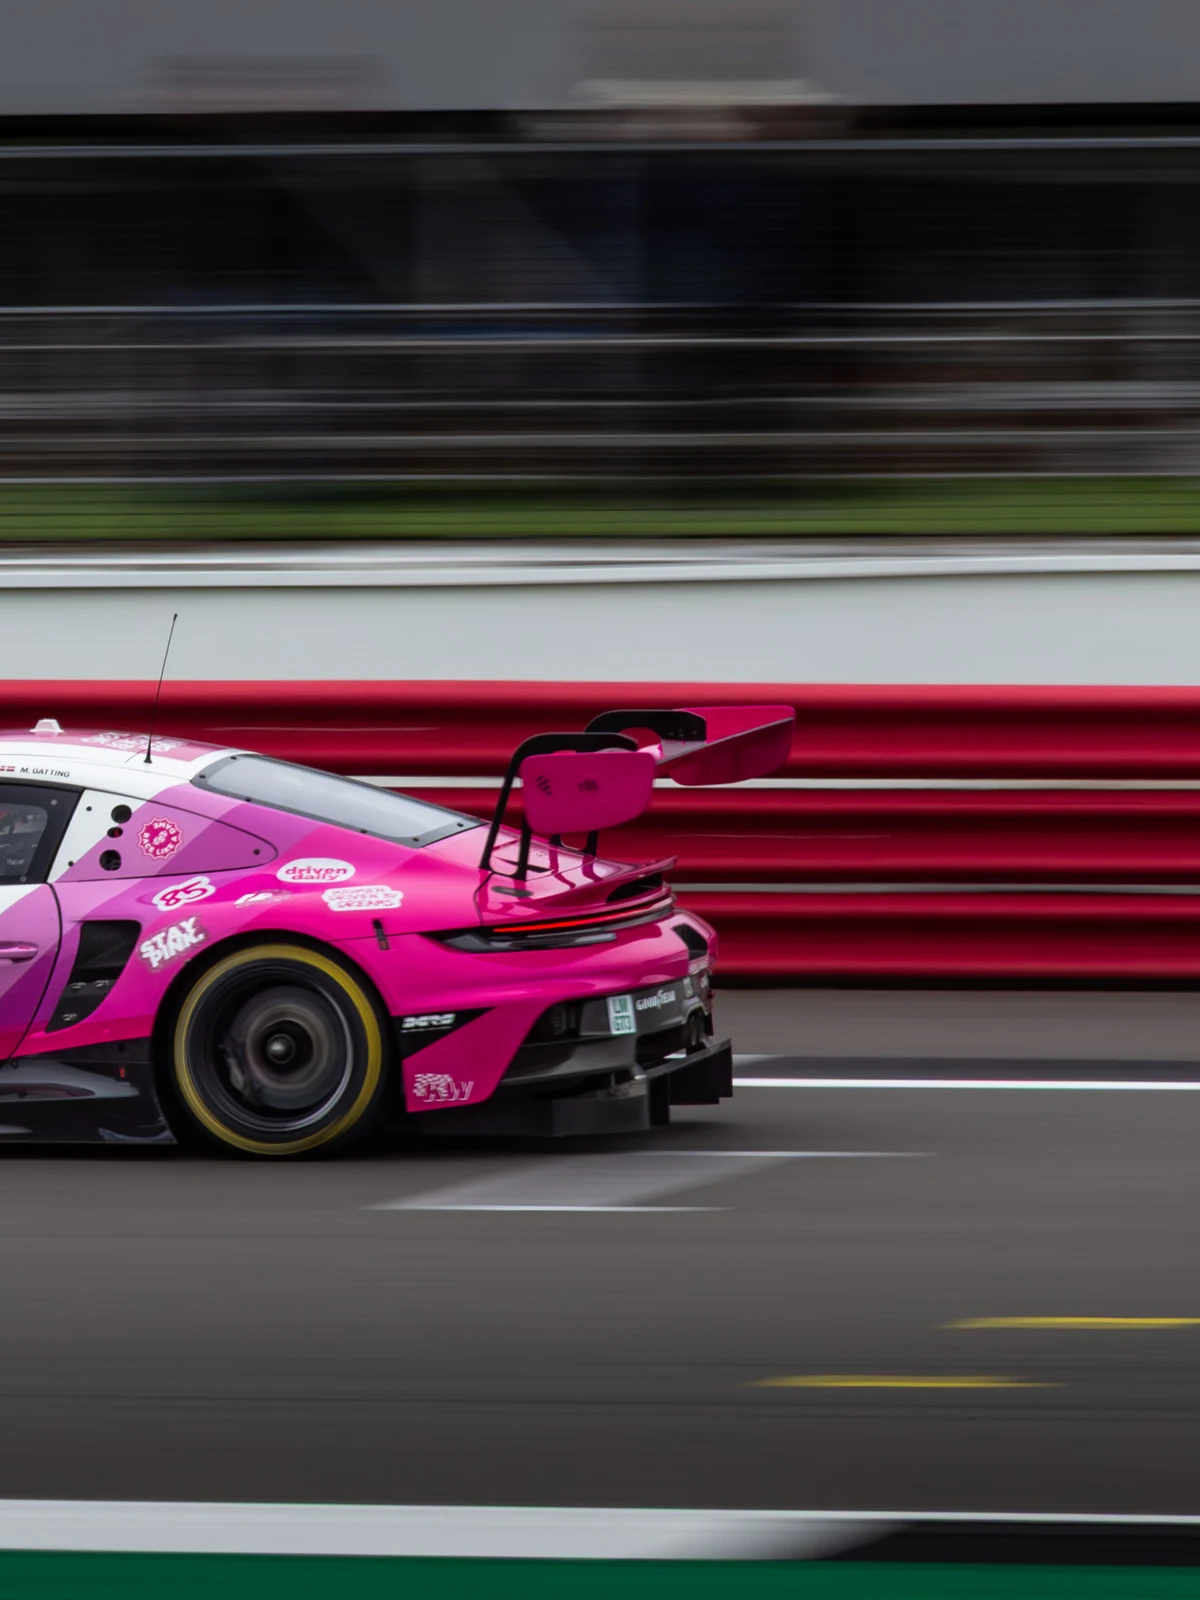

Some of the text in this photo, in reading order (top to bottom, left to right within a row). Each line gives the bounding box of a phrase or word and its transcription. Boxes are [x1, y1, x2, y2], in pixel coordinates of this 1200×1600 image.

[20, 766, 71, 779] M. GATTING
[285, 865, 348, 875] driven
[291, 873, 340, 881] daily
[160, 881, 209, 907] 85
[140, 916, 197, 959] STAY
